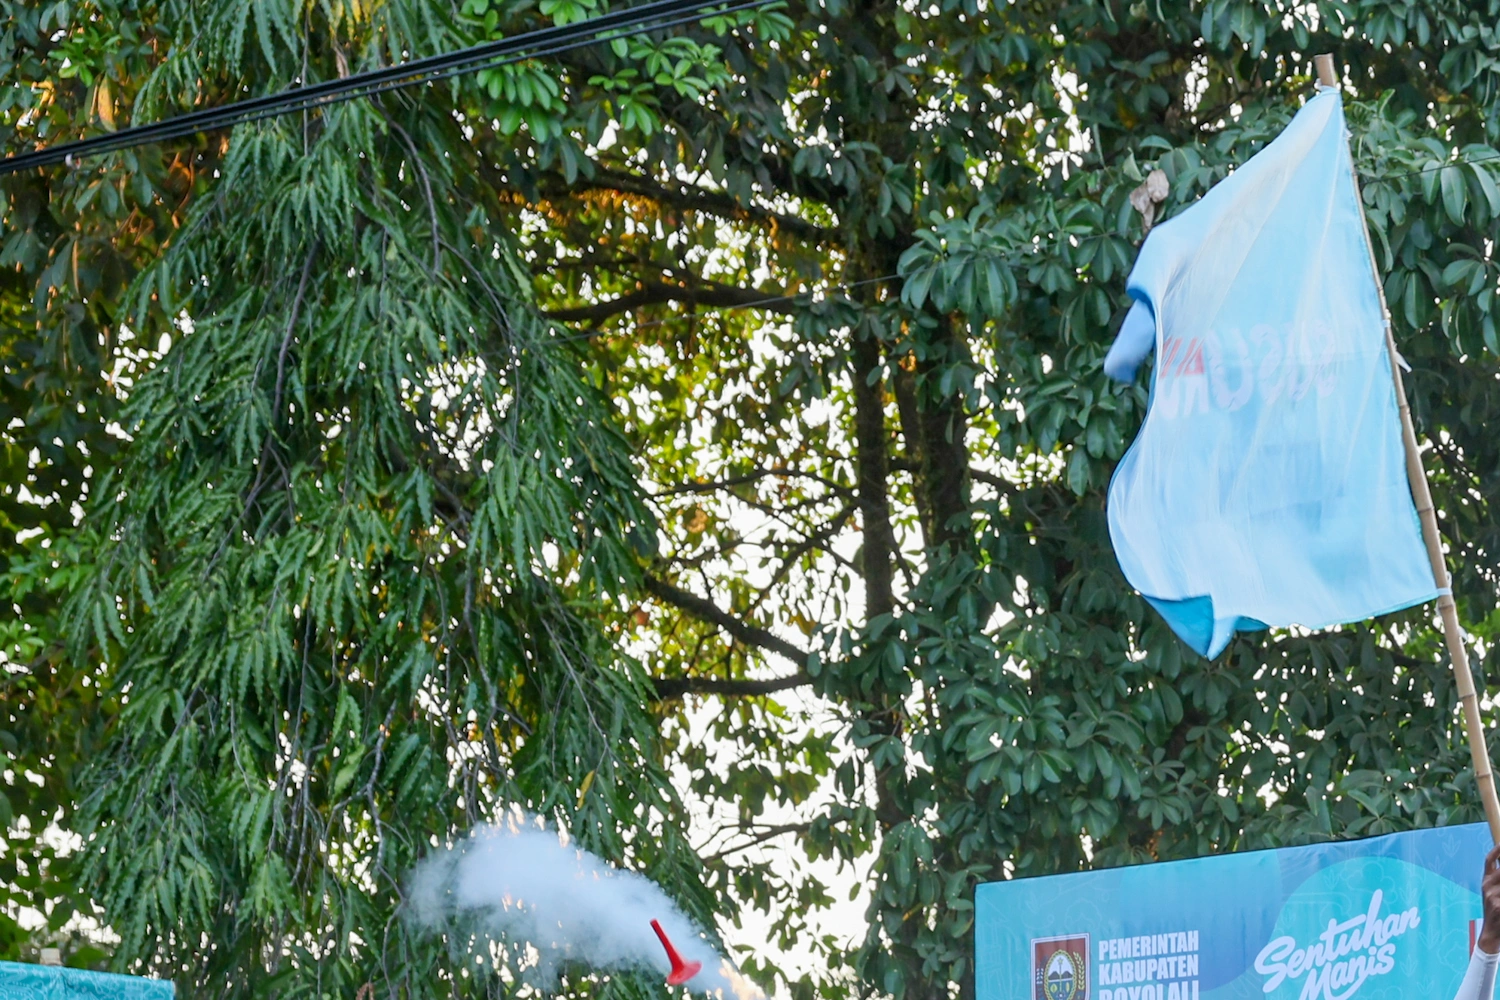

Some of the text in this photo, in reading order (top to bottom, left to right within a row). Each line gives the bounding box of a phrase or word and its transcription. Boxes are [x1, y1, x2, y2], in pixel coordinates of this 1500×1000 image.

[1099, 930, 1199, 961] PEMERINTAH
[1254, 889, 1421, 994] Sentuhan
[1099, 954, 1199, 986] KABUPATEN
